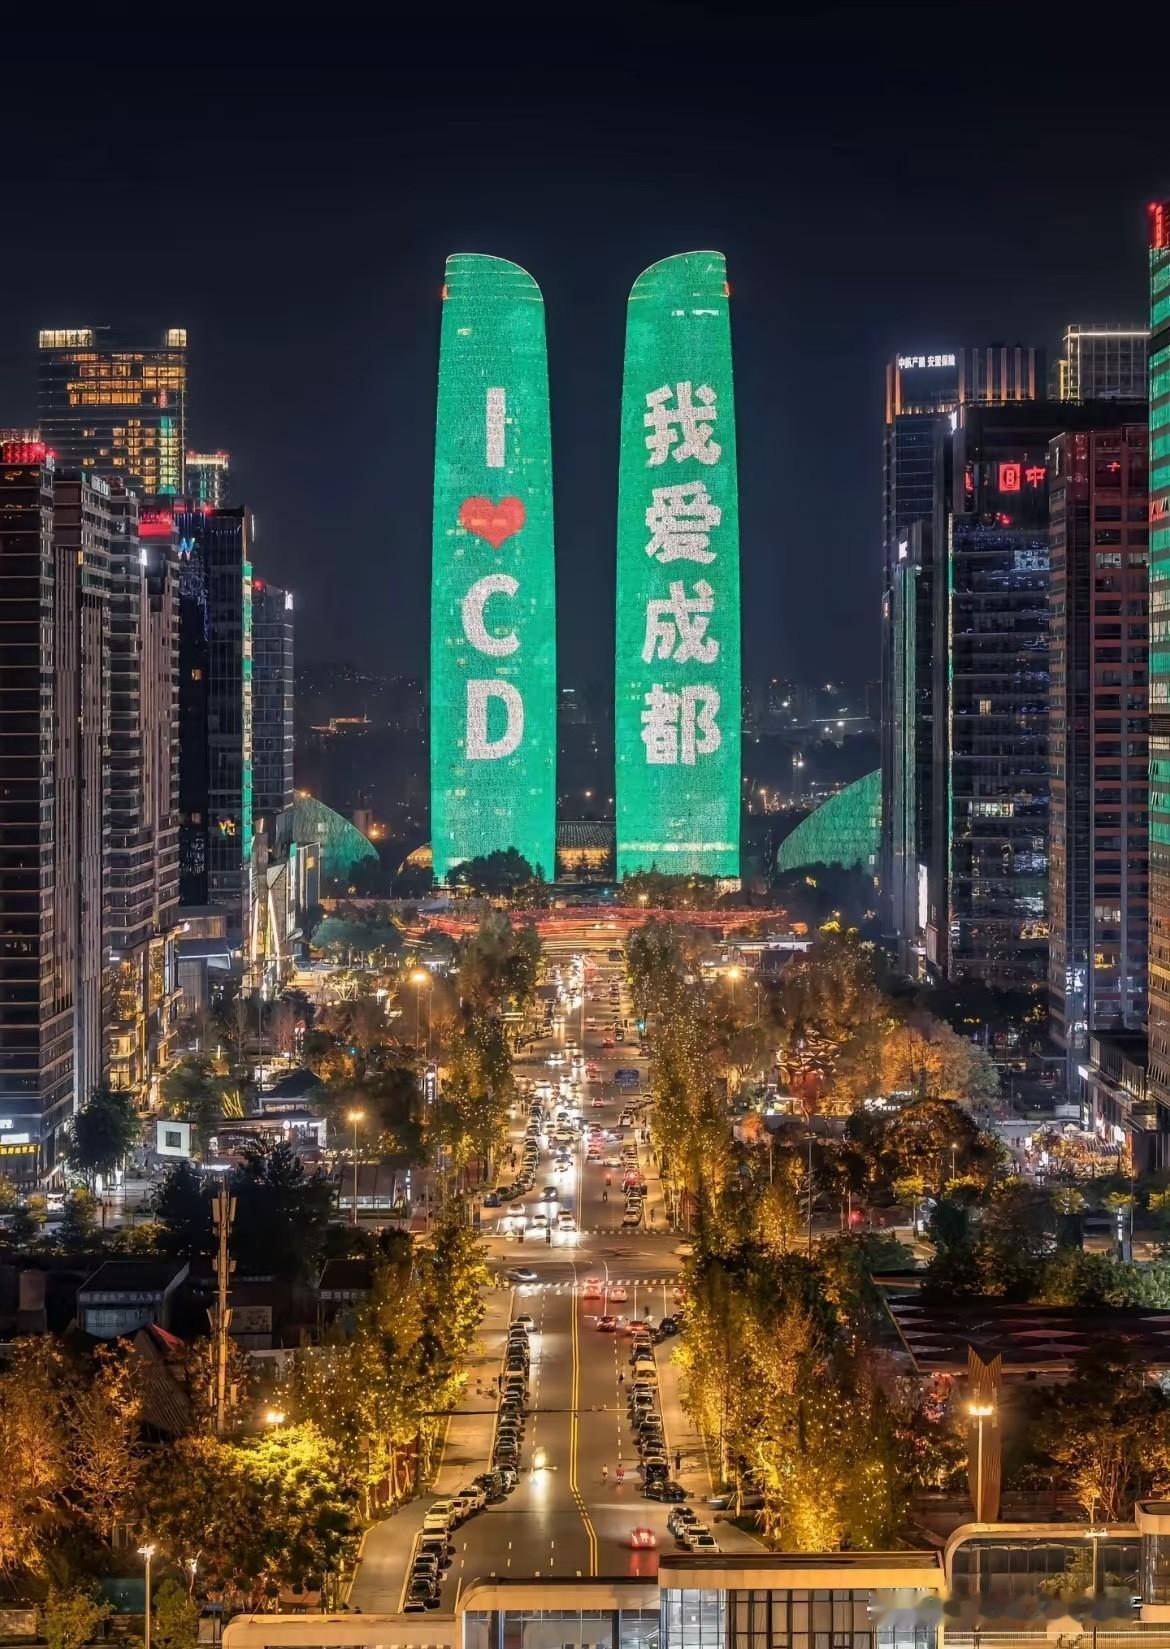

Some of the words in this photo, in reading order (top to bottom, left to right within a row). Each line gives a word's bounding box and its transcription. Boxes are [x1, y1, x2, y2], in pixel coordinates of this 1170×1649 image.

[485, 387, 507, 468] I
[641, 381, 722, 766] 我爱成都
